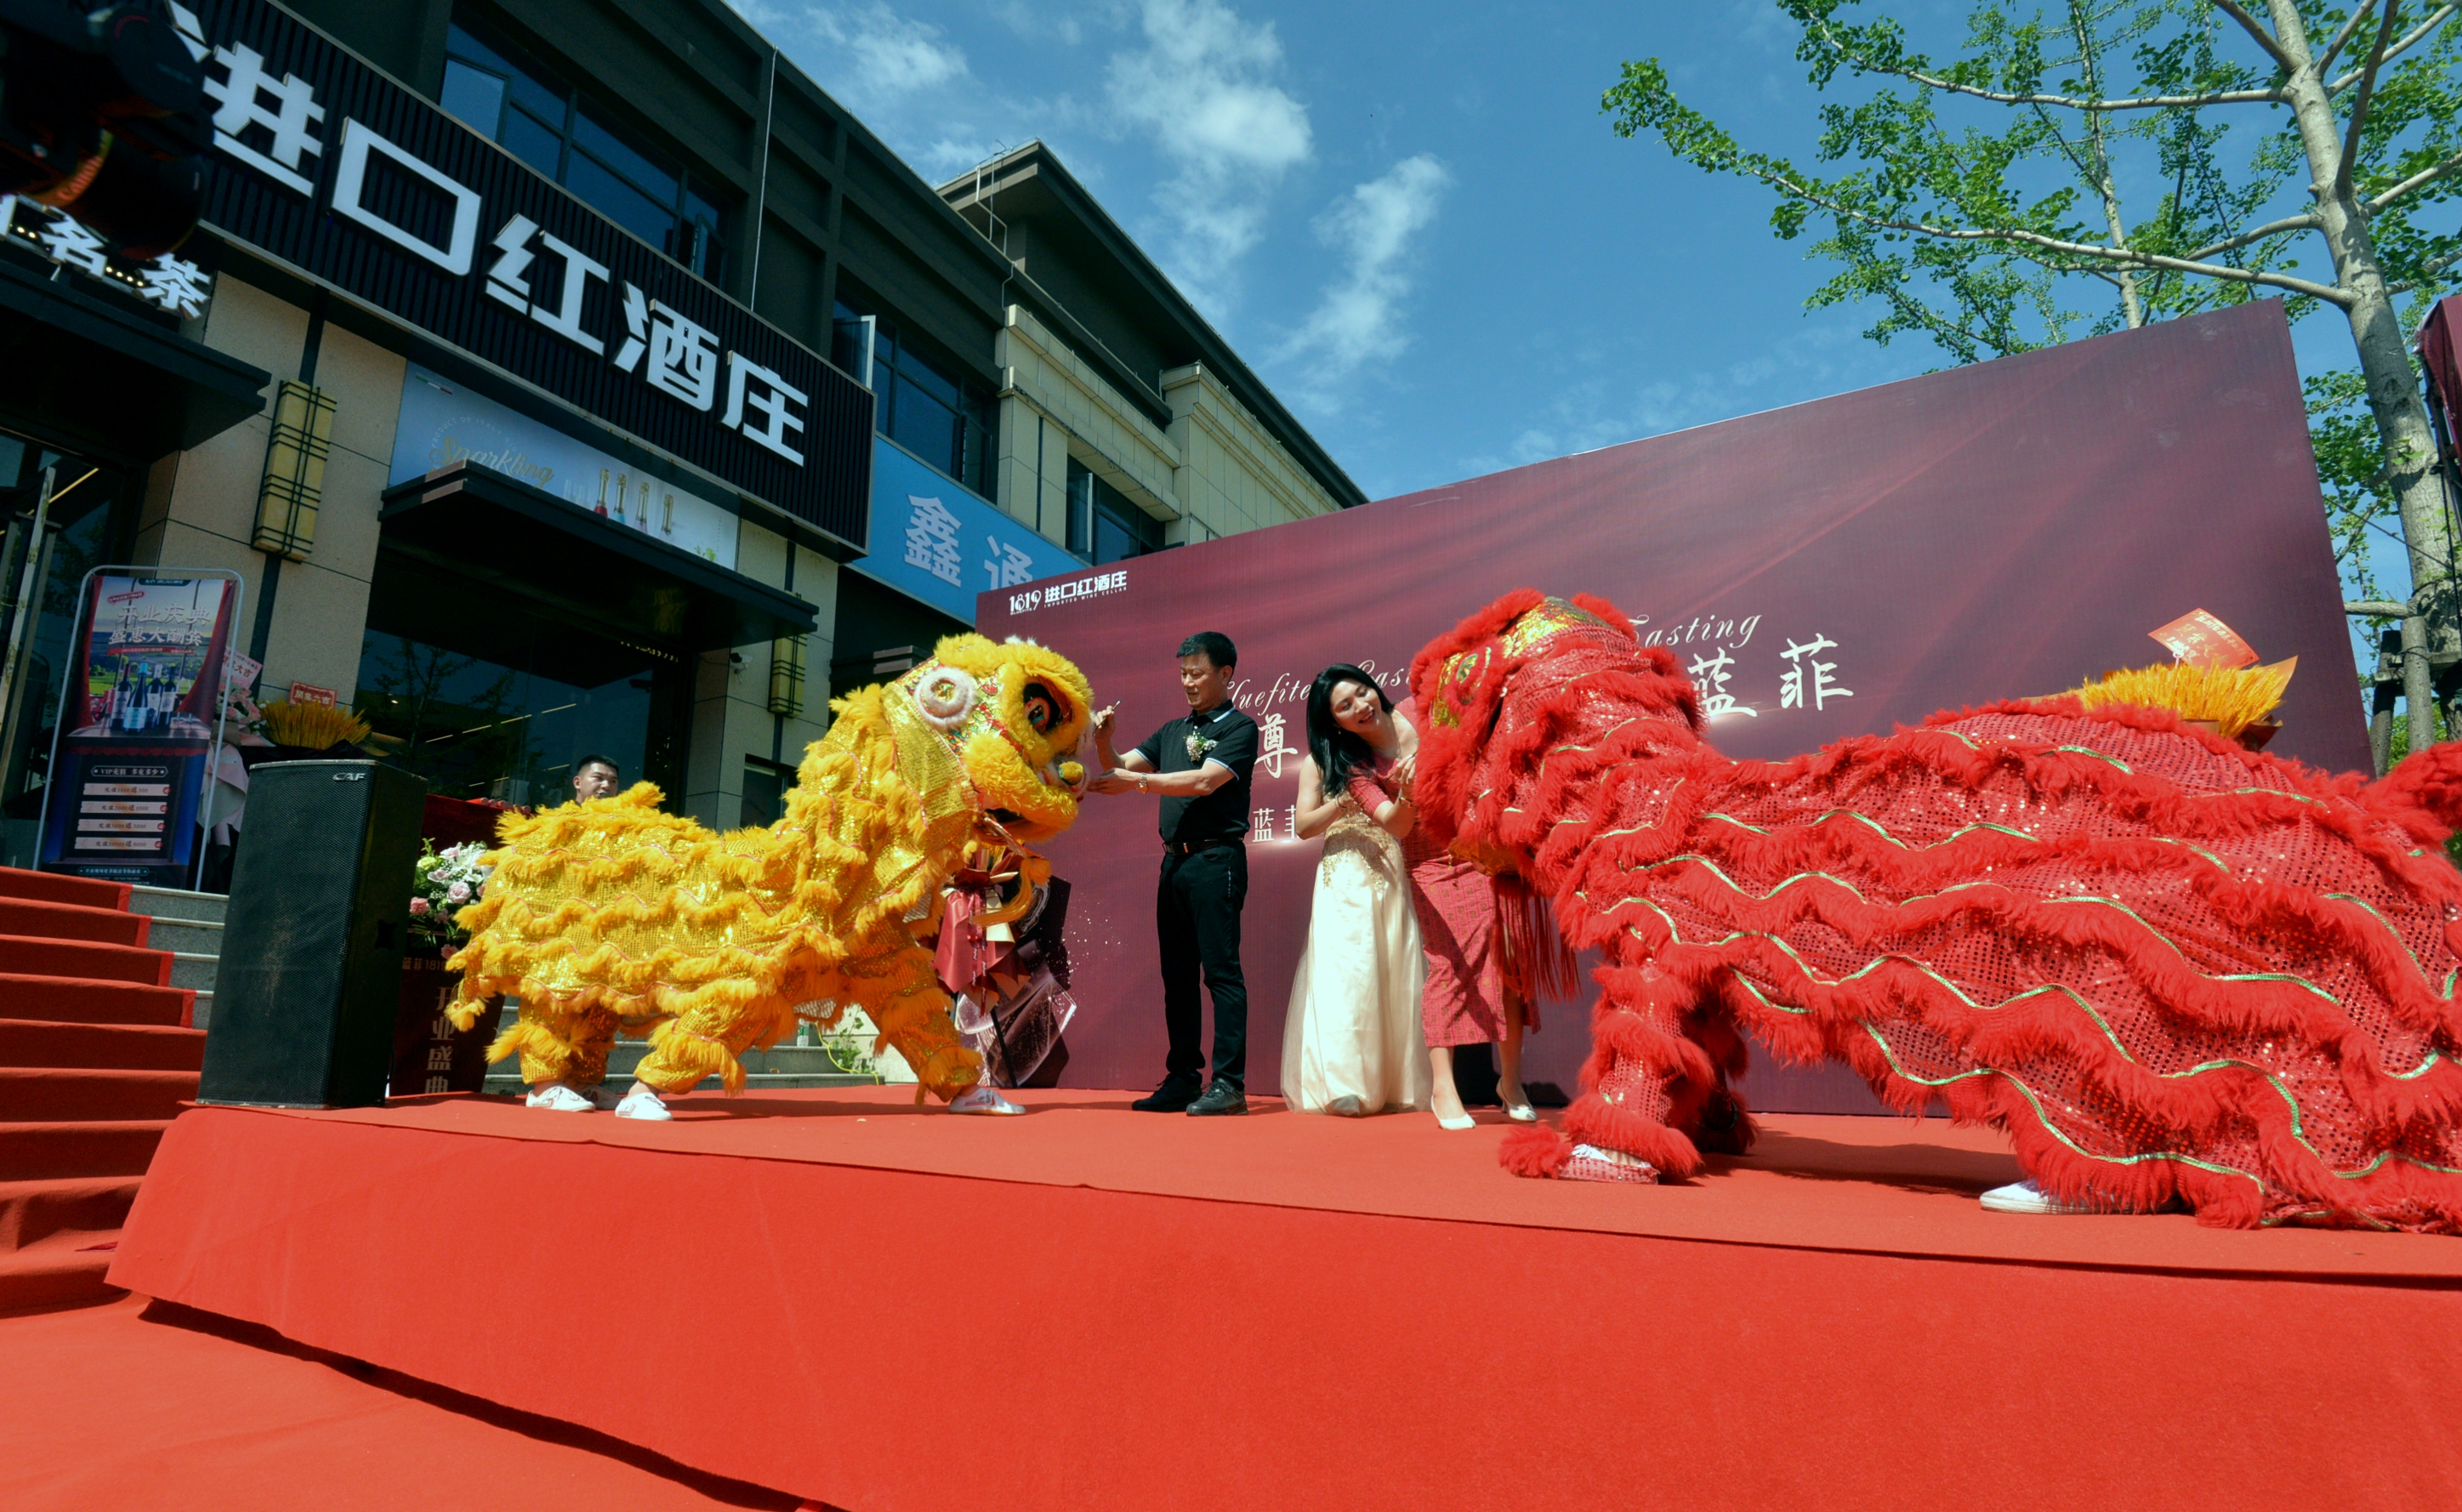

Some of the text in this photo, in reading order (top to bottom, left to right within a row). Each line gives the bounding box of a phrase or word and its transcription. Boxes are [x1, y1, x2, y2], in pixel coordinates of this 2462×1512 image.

[170, 0, 808, 467] 进口红酒庄
[0, 194, 212, 321] 名茶
[431, 418, 458, 448] PRODUCT
[476, 418, 503, 435] ITALY
[429, 436, 554, 488] Sparkling
[904, 494, 1032, 590] 鑫通
[1009, 590, 1042, 611] 1819
[1044, 571, 1128, 603] 进口红酒庄
[1044, 597, 1077, 608] IMPORTED
[1101, 587, 1127, 596] CELLAR
[117, 603, 211, 626] 开业庆典
[109, 628, 204, 646] 盛惠大酬宾
[1227, 673, 1311, 716] luefite
[1254, 633, 1854, 779] 尊 蓝菲
[333, 773, 366, 782] CAF
